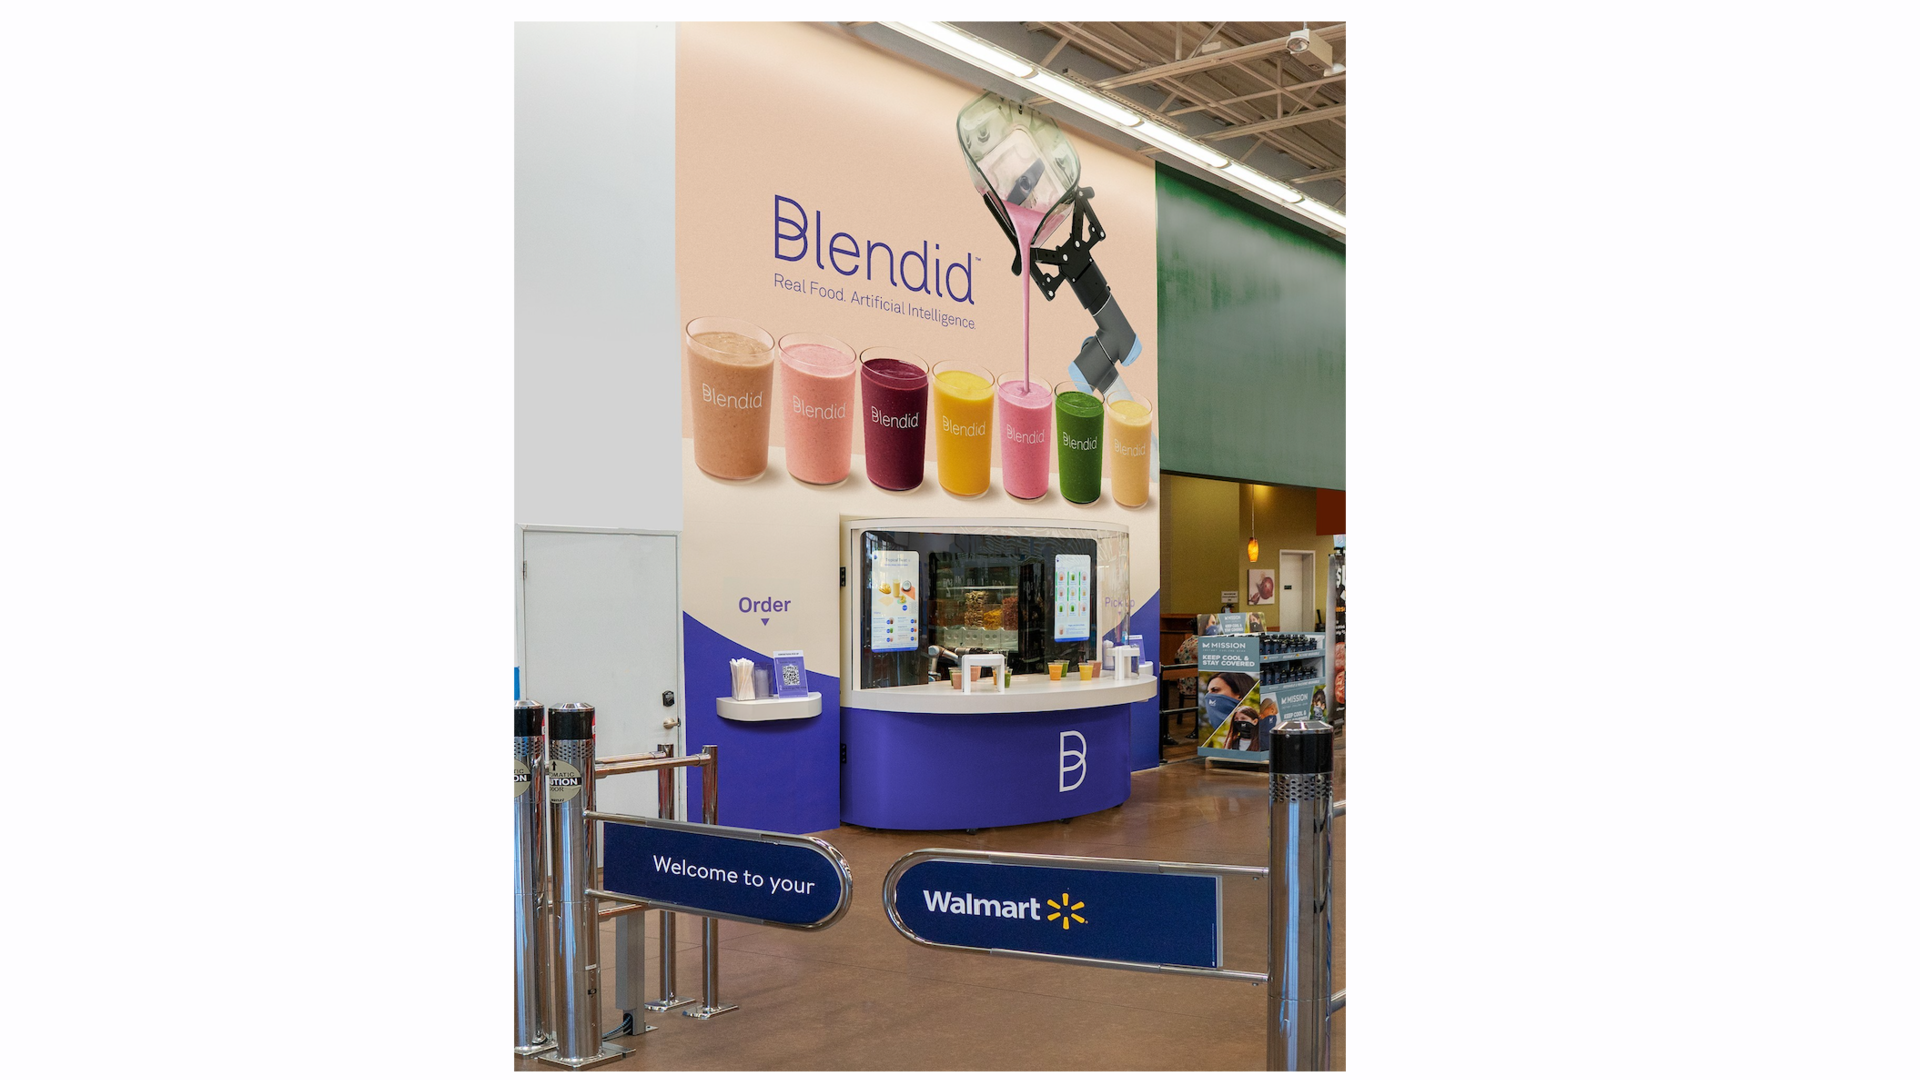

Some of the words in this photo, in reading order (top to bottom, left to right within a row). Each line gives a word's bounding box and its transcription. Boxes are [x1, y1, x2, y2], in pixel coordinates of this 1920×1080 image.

[774, 273, 806, 294] Real
[810, 281, 847, 302] Food.
[851, 291, 905, 315] Artificial
[702, 383, 763, 410] Blendid
[792, 395, 847, 420] Blendid
[871, 406, 920, 429] Blendid
[942, 416, 987, 437] Blendid
[1006, 424, 1046, 445] Blendid
[1062, 431, 1098, 451] Blendid
[1114, 438, 1147, 457] Blendid
[738, 596, 792, 613] Order
[1105, 596, 1123, 608] Pick
[1211, 642, 1246, 650] MISSION
[1287, 693, 1309, 702] MISSION
[550, 777, 578, 786] UTION
[653, 854, 738, 884] Welcome
[743, 869, 764, 888] to
[769, 876, 815, 895] your
[923, 889, 1041, 921] Walmart
